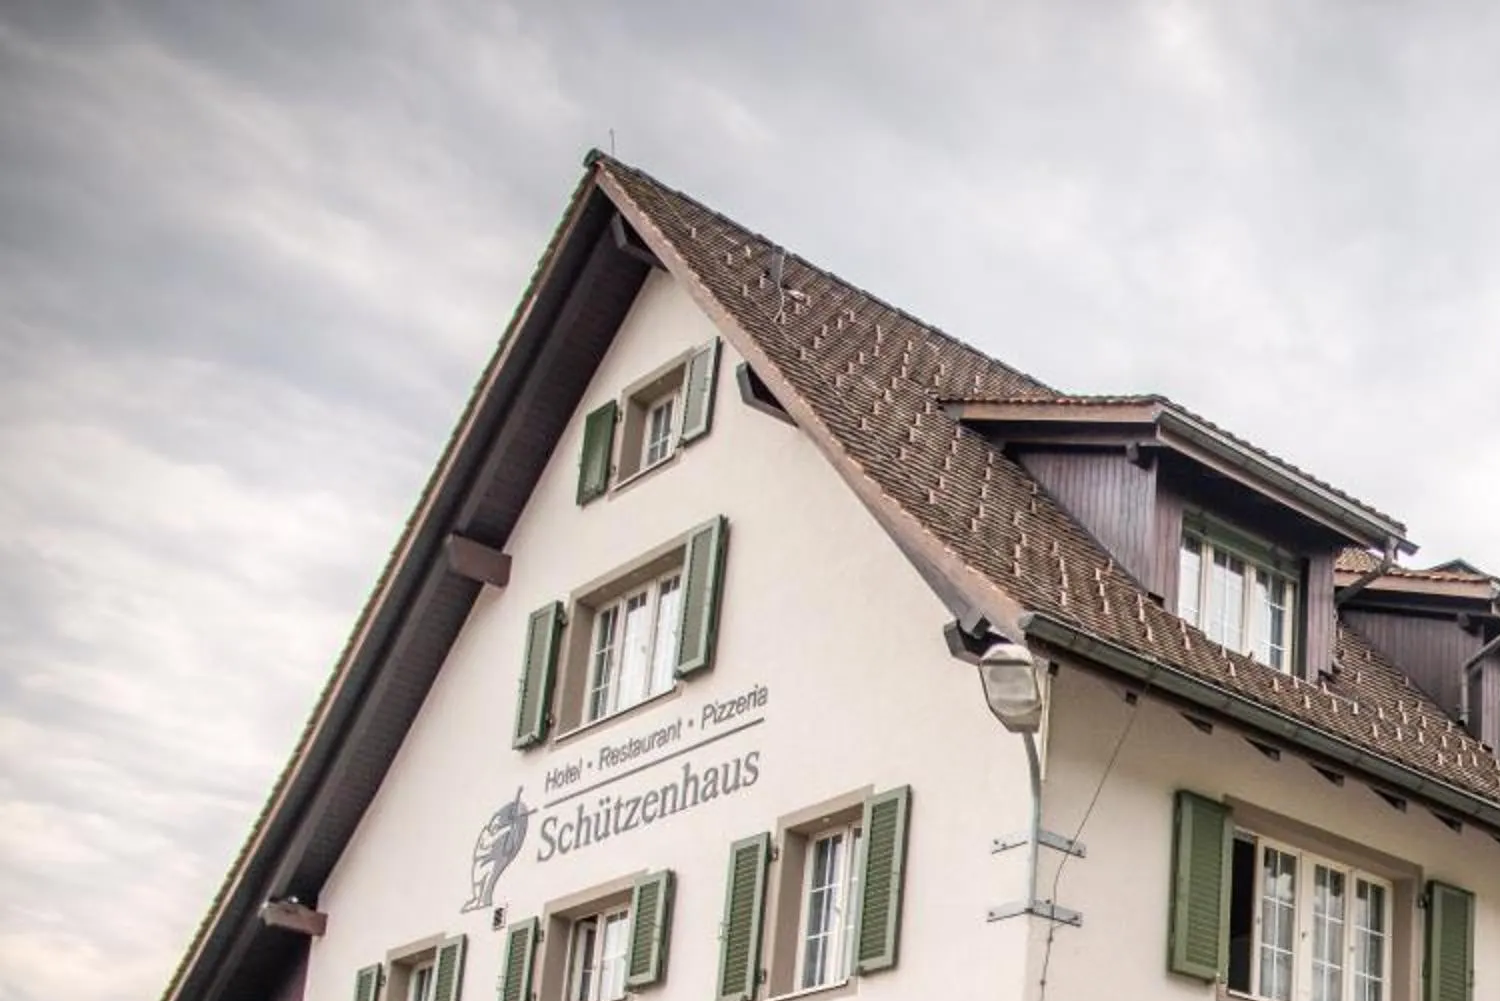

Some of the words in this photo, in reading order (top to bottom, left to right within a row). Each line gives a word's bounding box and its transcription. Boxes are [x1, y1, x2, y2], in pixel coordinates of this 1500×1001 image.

[544, 758, 583, 793] Hotel
[598, 719, 683, 771] Restaurant
[701, 683, 769, 729] Pizzeria
[537, 751, 760, 862] Schützenhaus
